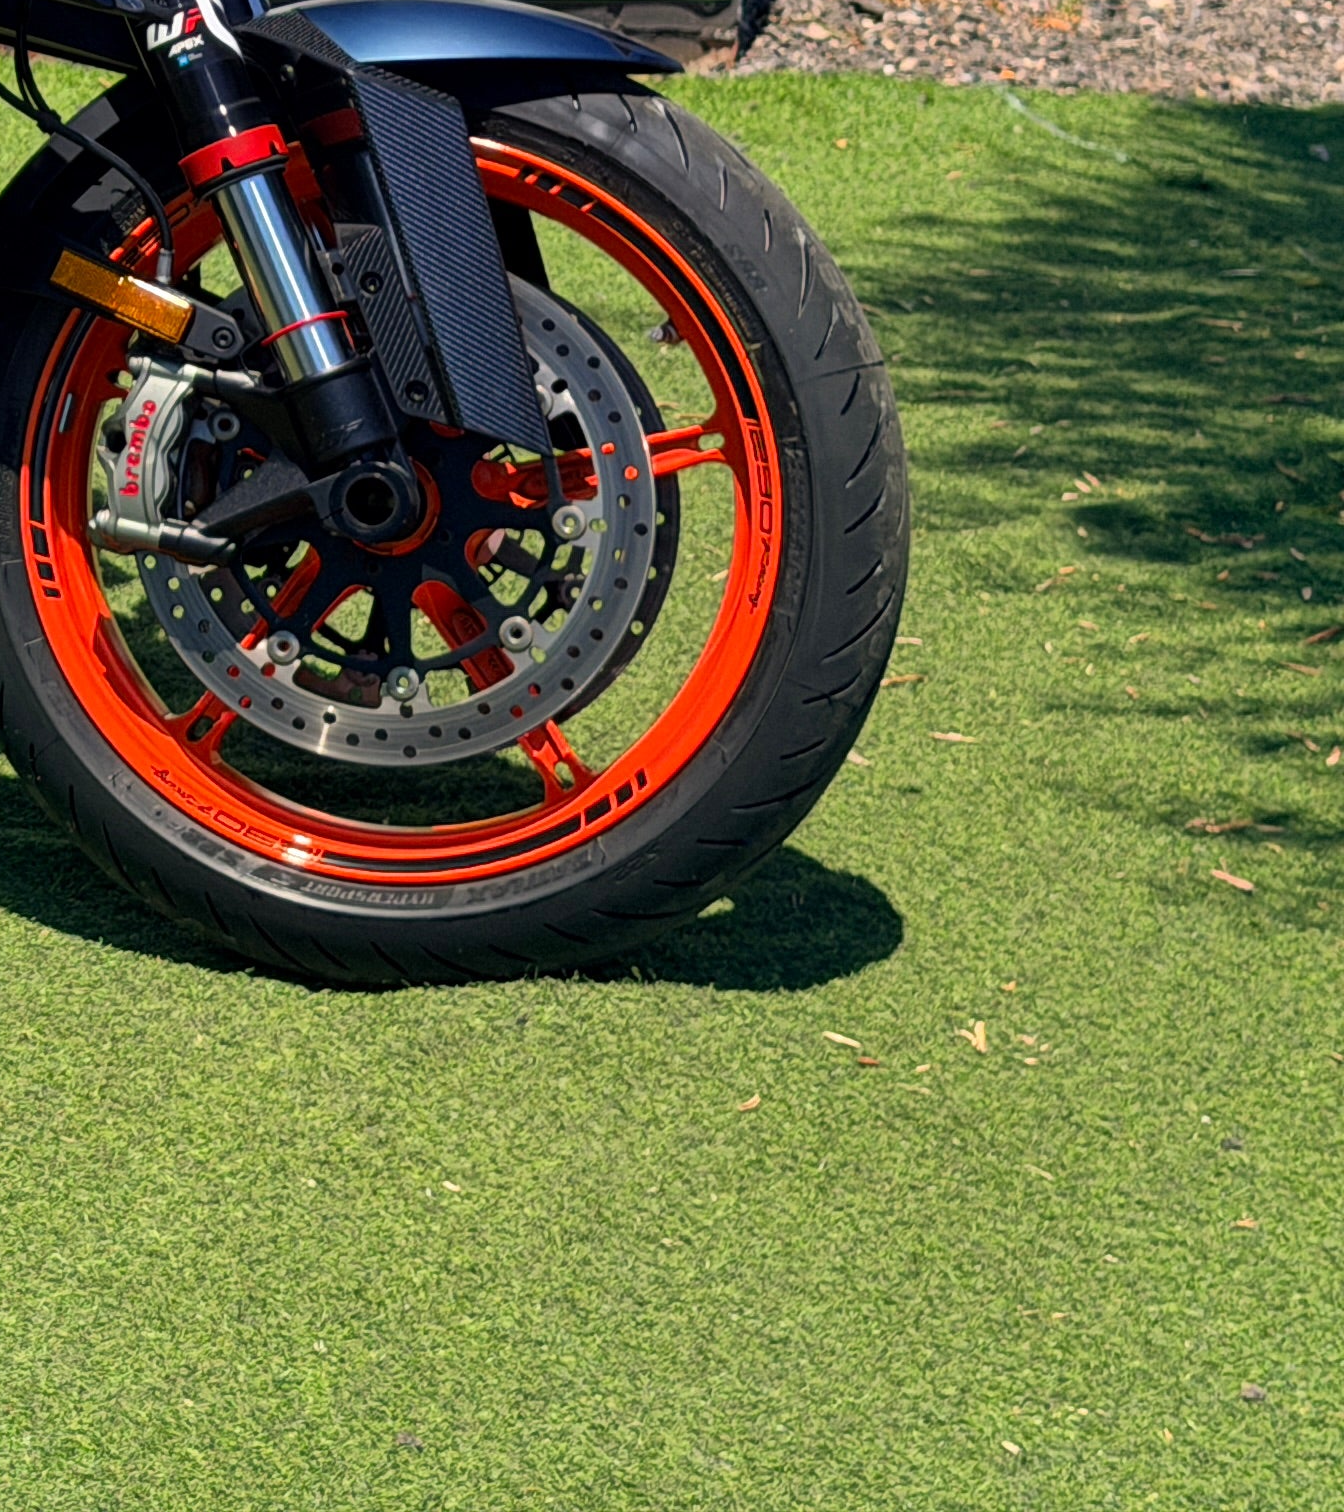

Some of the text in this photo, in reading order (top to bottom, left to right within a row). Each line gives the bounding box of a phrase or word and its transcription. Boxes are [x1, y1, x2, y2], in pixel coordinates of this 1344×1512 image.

[168, 34, 205, 59] APEX
[119, 400, 157, 497] brembo
[745, 418, 773, 535] 1290
